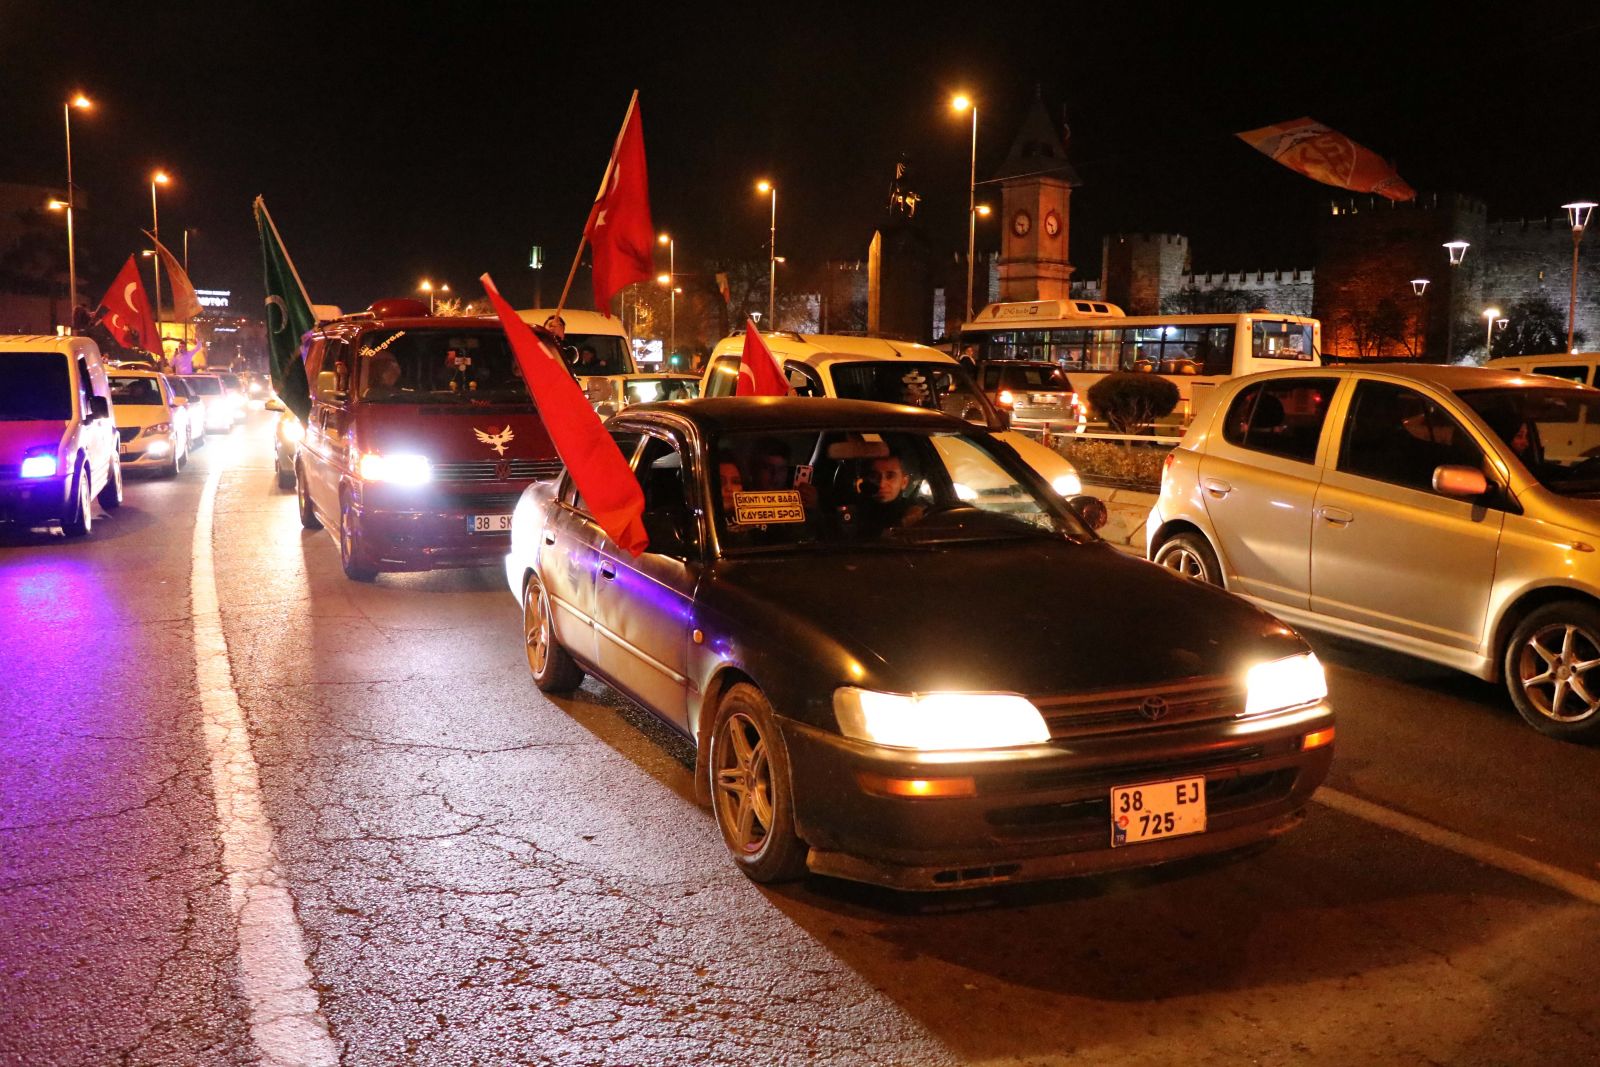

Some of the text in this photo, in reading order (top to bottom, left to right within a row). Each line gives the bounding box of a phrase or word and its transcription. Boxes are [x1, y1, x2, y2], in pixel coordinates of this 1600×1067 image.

[761, 495, 777, 504] YOK
[778, 495, 798, 503] BABA
[777, 509, 801, 519] SPOR
[476, 516, 490, 530] 38
[1119, 782, 1199, 813] 38 EJ
[1139, 811, 1175, 837] 725
